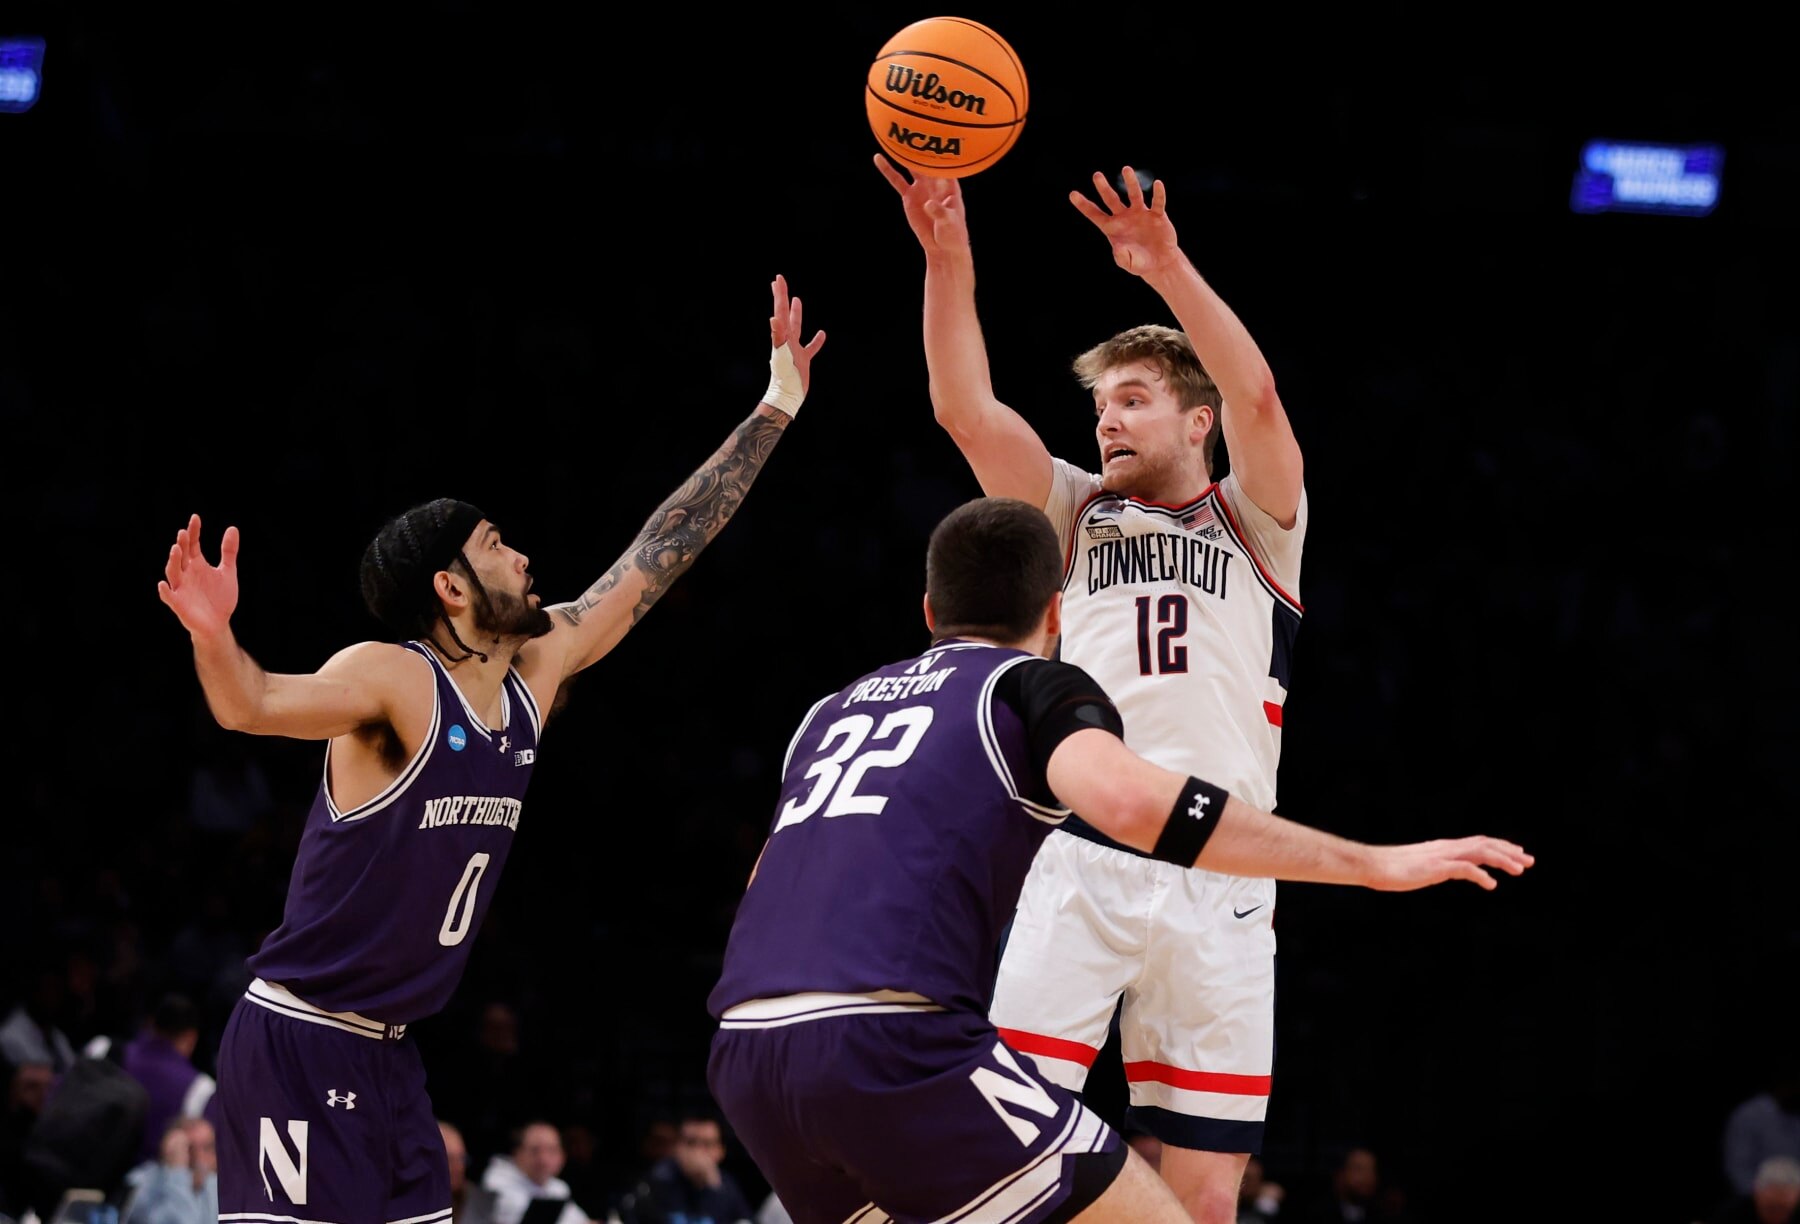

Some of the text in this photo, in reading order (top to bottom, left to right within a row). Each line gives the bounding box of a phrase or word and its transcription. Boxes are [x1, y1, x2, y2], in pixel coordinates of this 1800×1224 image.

[886, 64, 986, 116] Wilson
[888, 121, 961, 156] NCAA
[1087, 532, 1234, 600] CONNECTICUT
[904, 651, 946, 675] N
[1135, 594, 1189, 676] 12
[842, 666, 957, 709] PRESTON
[774, 705, 934, 834] 32
[438, 852, 490, 947] 0
[969, 1041, 1060, 1148] N
[259, 1117, 309, 1205] N
